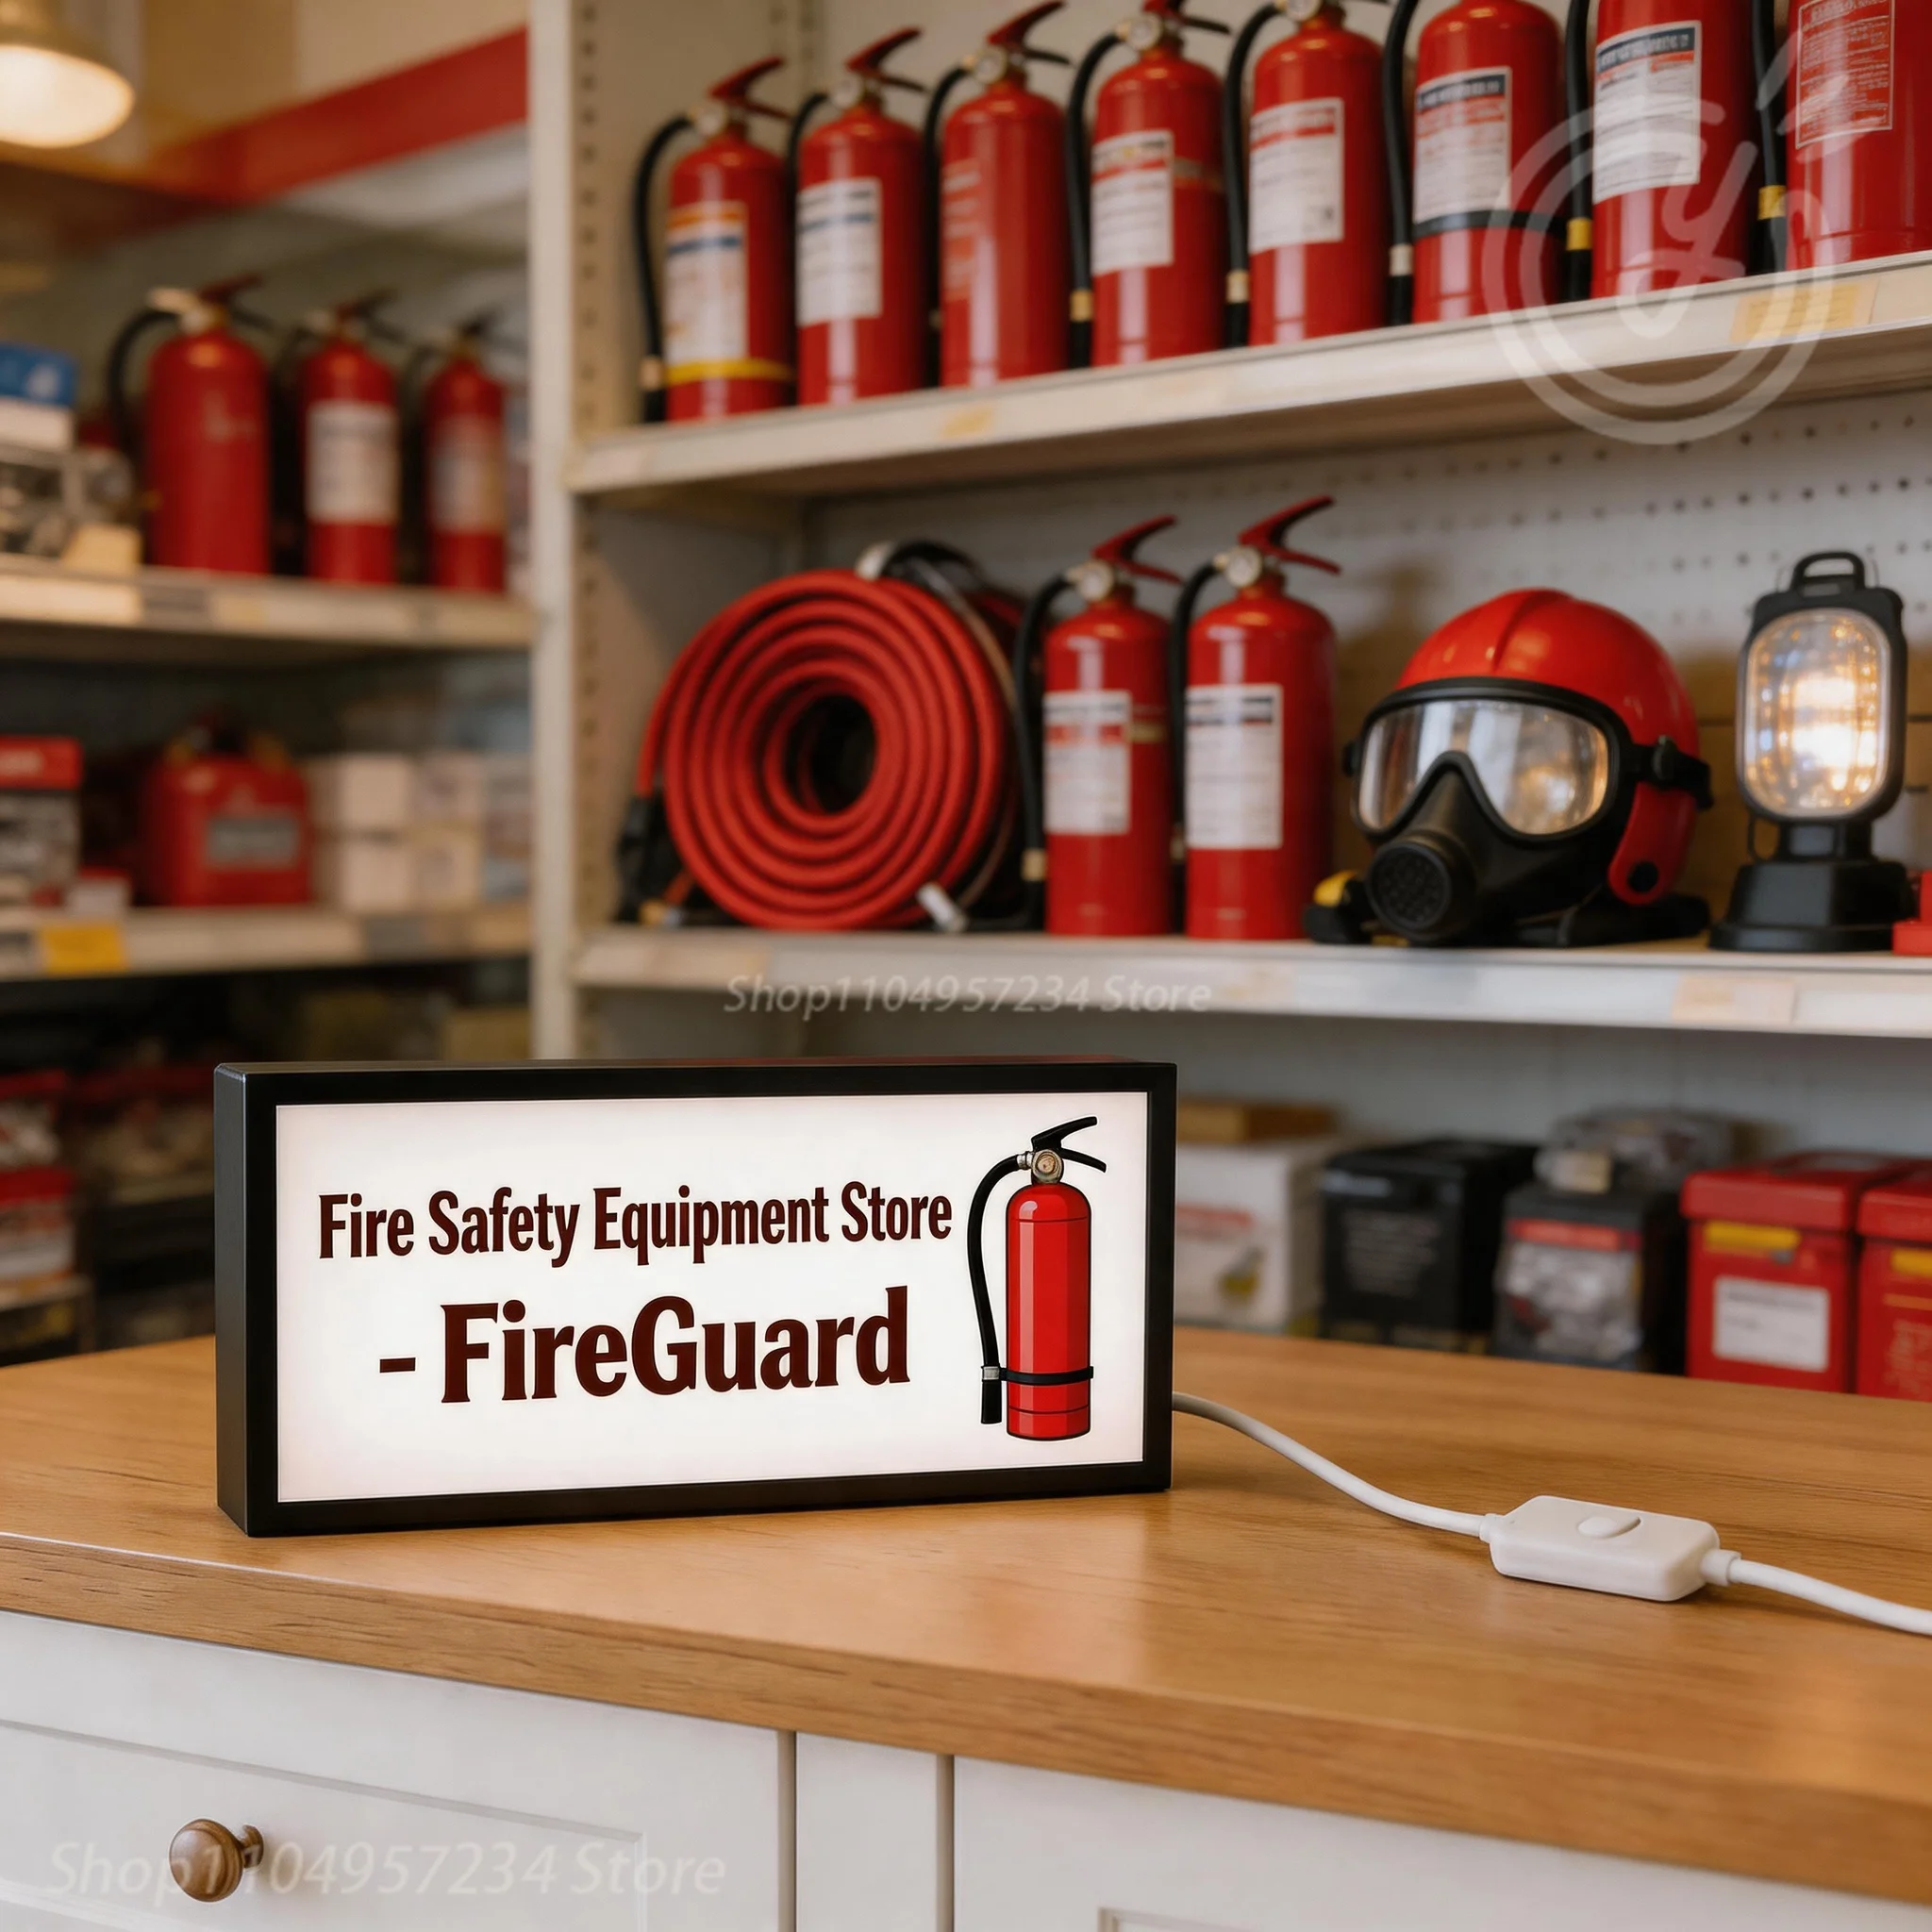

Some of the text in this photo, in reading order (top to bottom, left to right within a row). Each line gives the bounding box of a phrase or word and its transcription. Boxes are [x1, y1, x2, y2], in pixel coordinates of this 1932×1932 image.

[318, 1180, 953, 1269] Fire Safety Equipment Store
[440, 1285, 911, 1404] FireGuard
